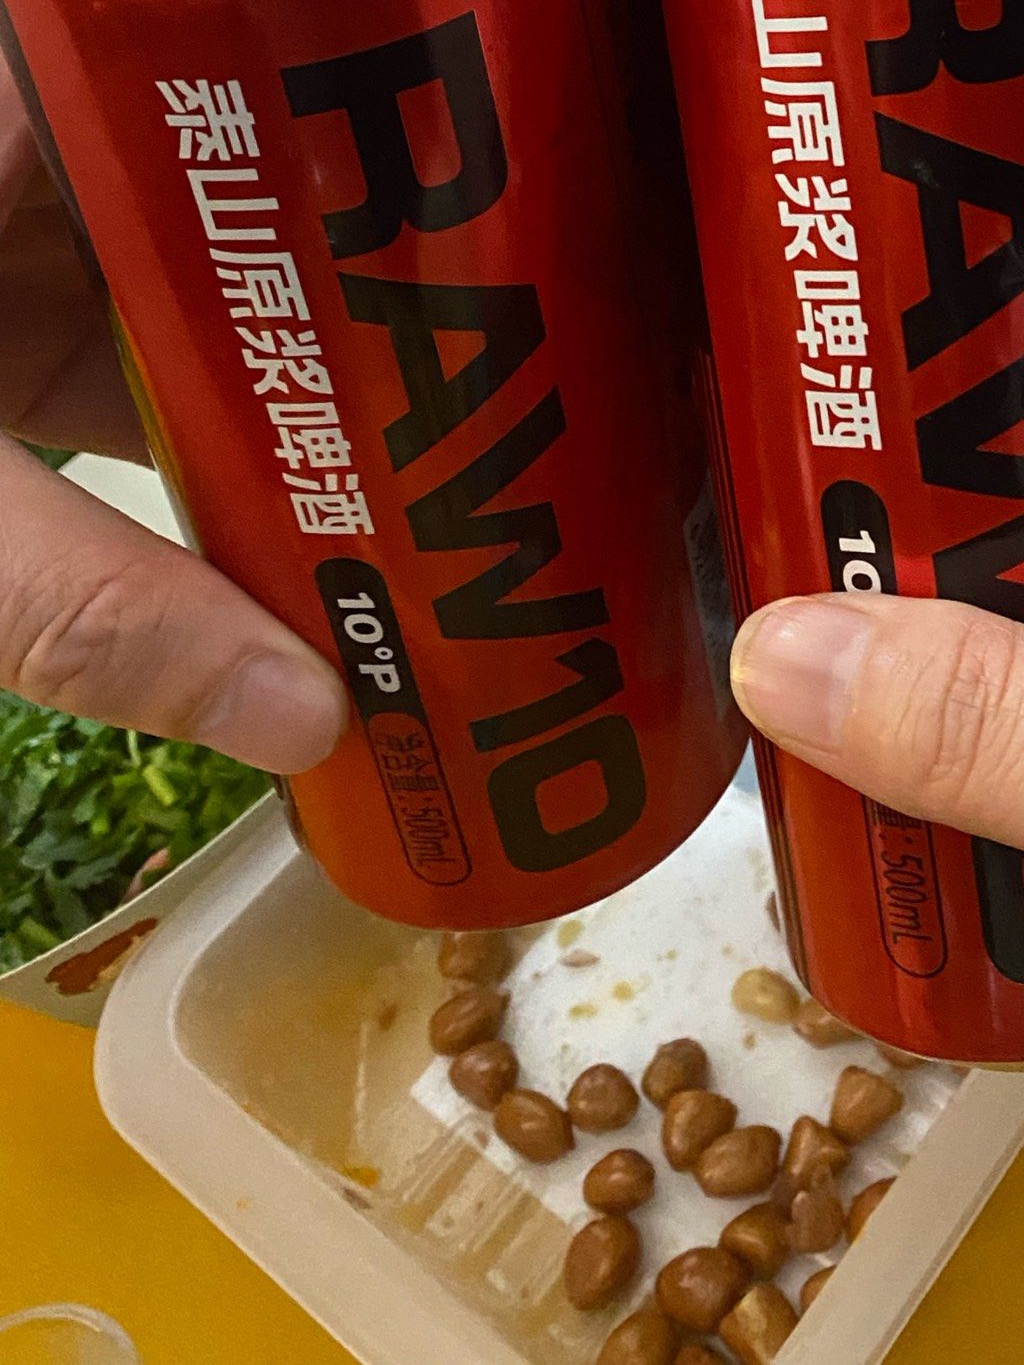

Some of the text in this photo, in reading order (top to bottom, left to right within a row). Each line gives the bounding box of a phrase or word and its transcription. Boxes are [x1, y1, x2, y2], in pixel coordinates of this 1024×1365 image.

[154, 78, 375, 536] 泰山原浆啤酒
[279, 10, 647, 874] RAW10
[836, 530, 881, 593] 10
